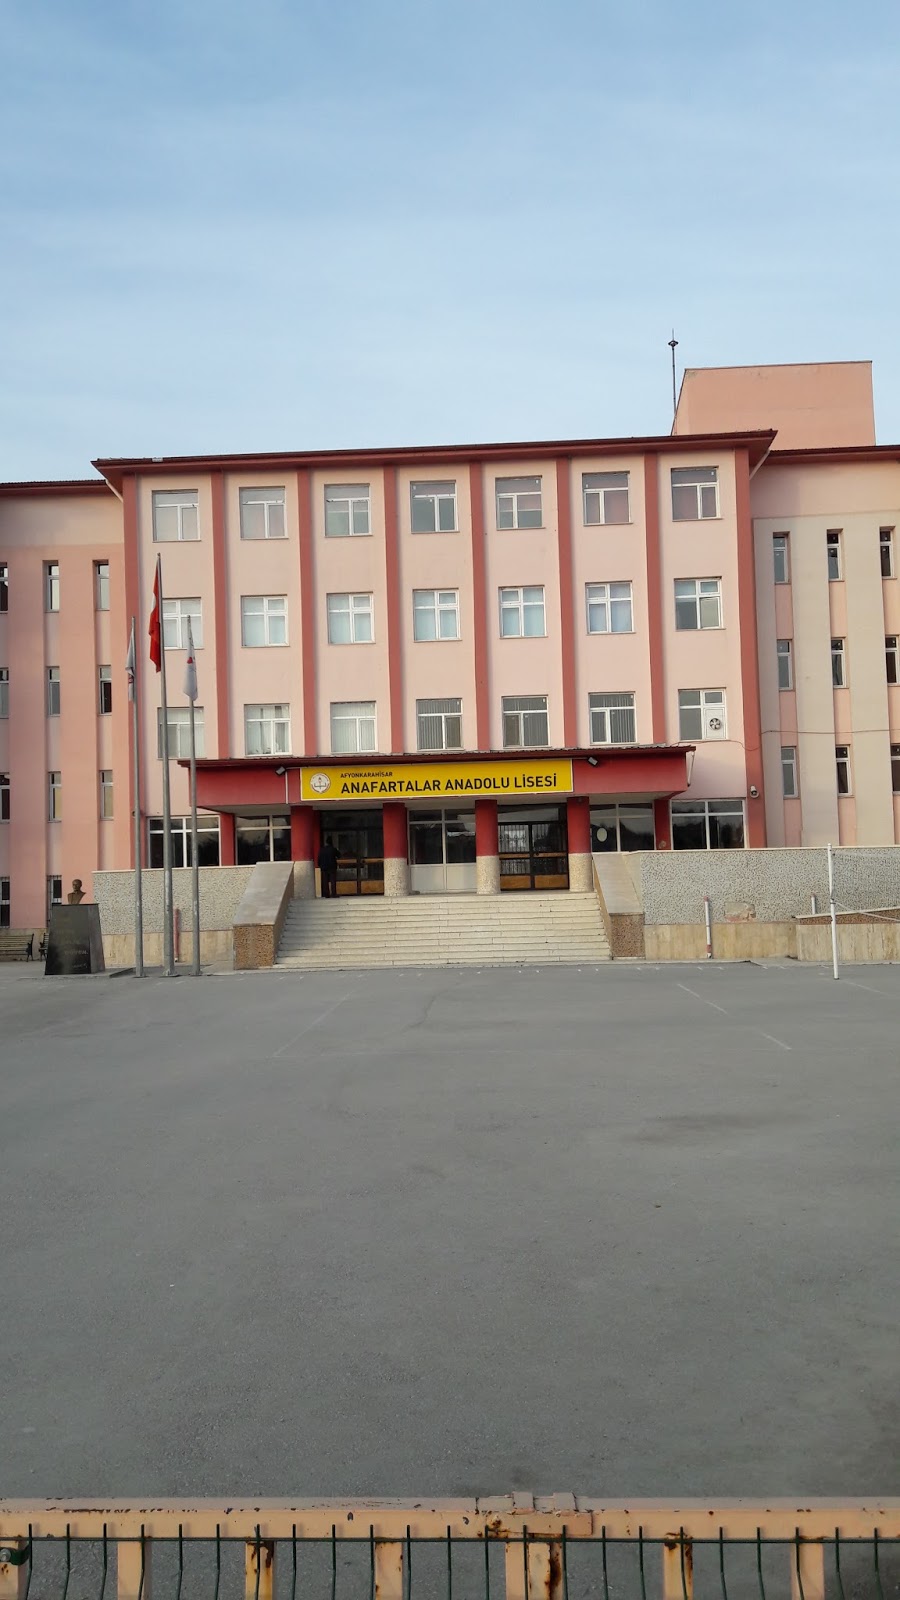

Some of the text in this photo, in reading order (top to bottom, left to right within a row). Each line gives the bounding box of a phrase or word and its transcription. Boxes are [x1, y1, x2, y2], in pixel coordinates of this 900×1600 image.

[340, 780, 441, 794] ANAFARTALAR
[445, 777, 510, 790] ANADOLU
[514, 773, 557, 788] LİSESİ
